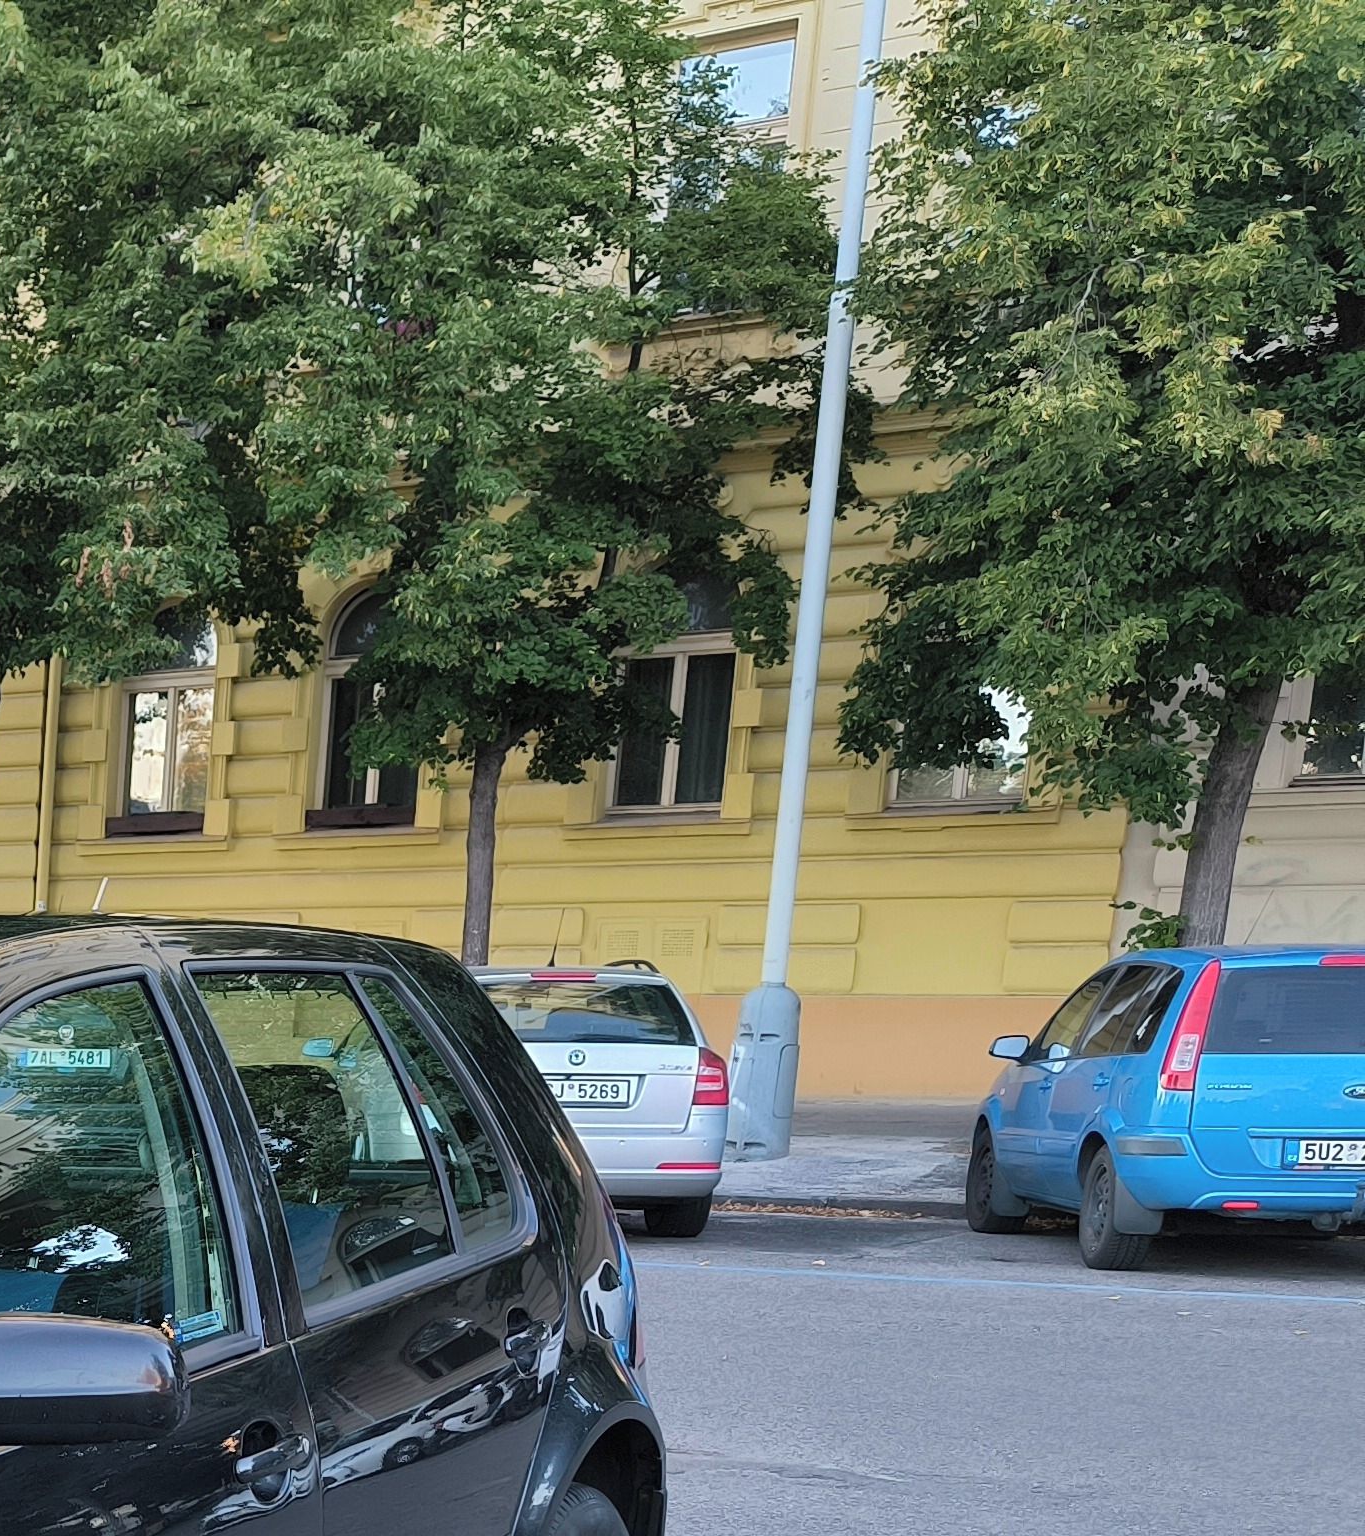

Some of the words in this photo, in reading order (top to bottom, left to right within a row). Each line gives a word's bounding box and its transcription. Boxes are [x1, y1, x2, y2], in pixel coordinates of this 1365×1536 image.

[30, 1050, 57, 1065] 7AL
[68, 1050, 104, 1065] 5481
[578, 1083, 620, 1099] 5269
[1304, 1143, 1344, 1161] 5U2
